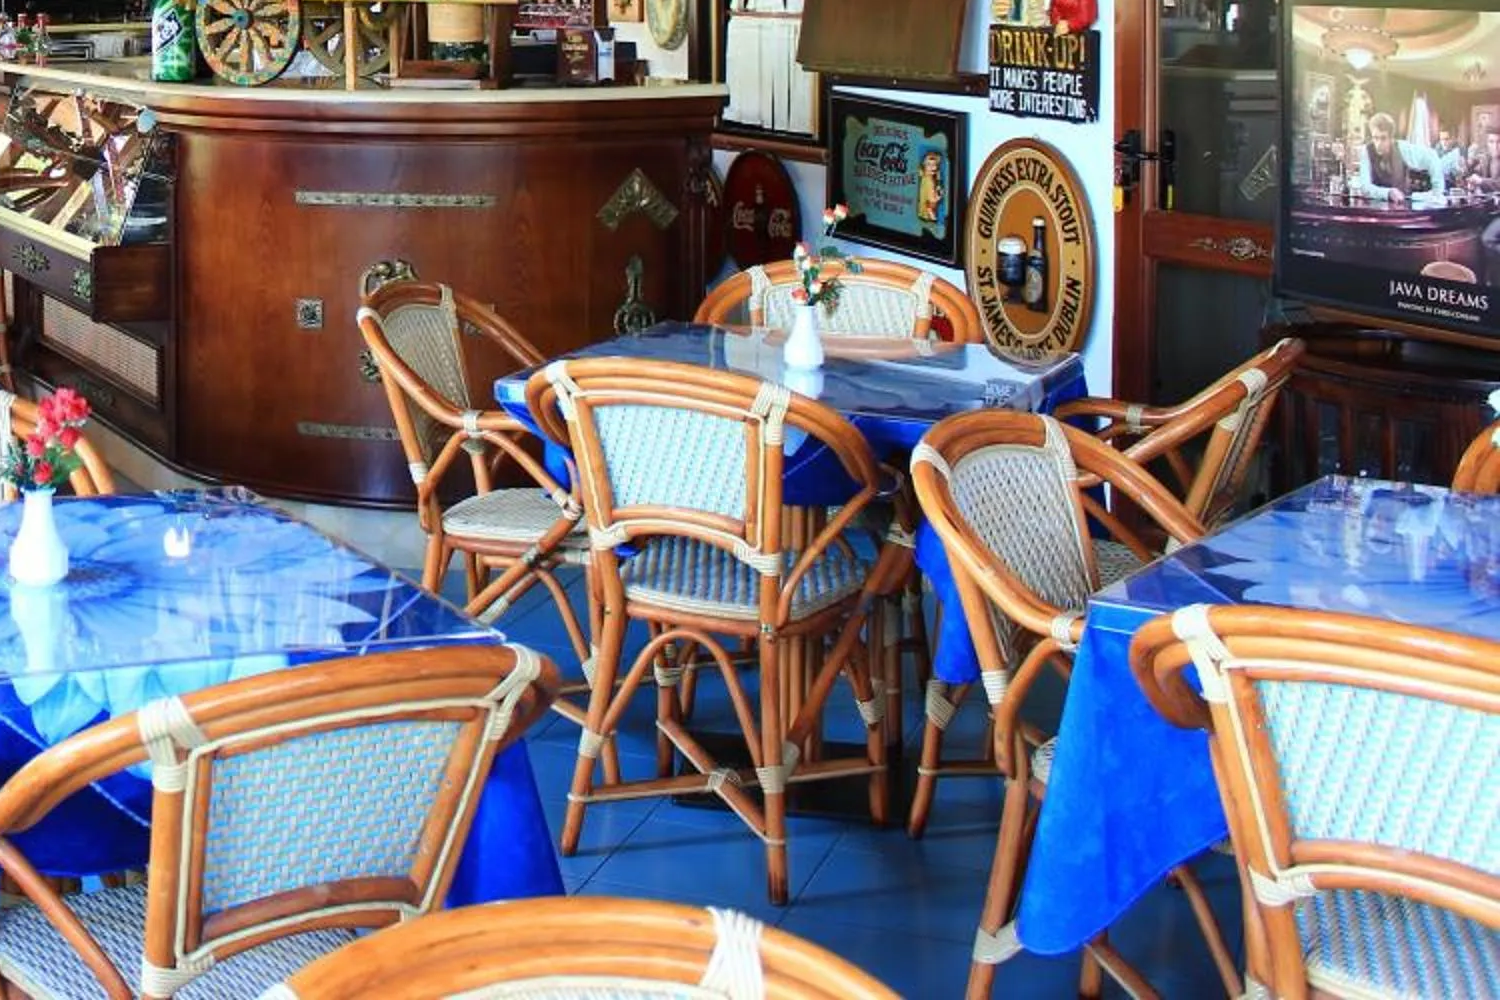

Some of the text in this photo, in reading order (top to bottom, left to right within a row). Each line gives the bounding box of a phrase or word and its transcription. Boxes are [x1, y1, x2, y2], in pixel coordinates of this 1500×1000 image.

[989, 29, 1085, 70] DRINK-UP!
[990, 66, 1083, 96] IT MAKES PEOPLE
[988, 88, 1015, 111] MORE
[977, 157, 1081, 245] GUINNESS EXTRA STOUT
[1051, 275, 1082, 347] DUBLIN
[1389, 280, 1489, 312] JAVA DREAMS
